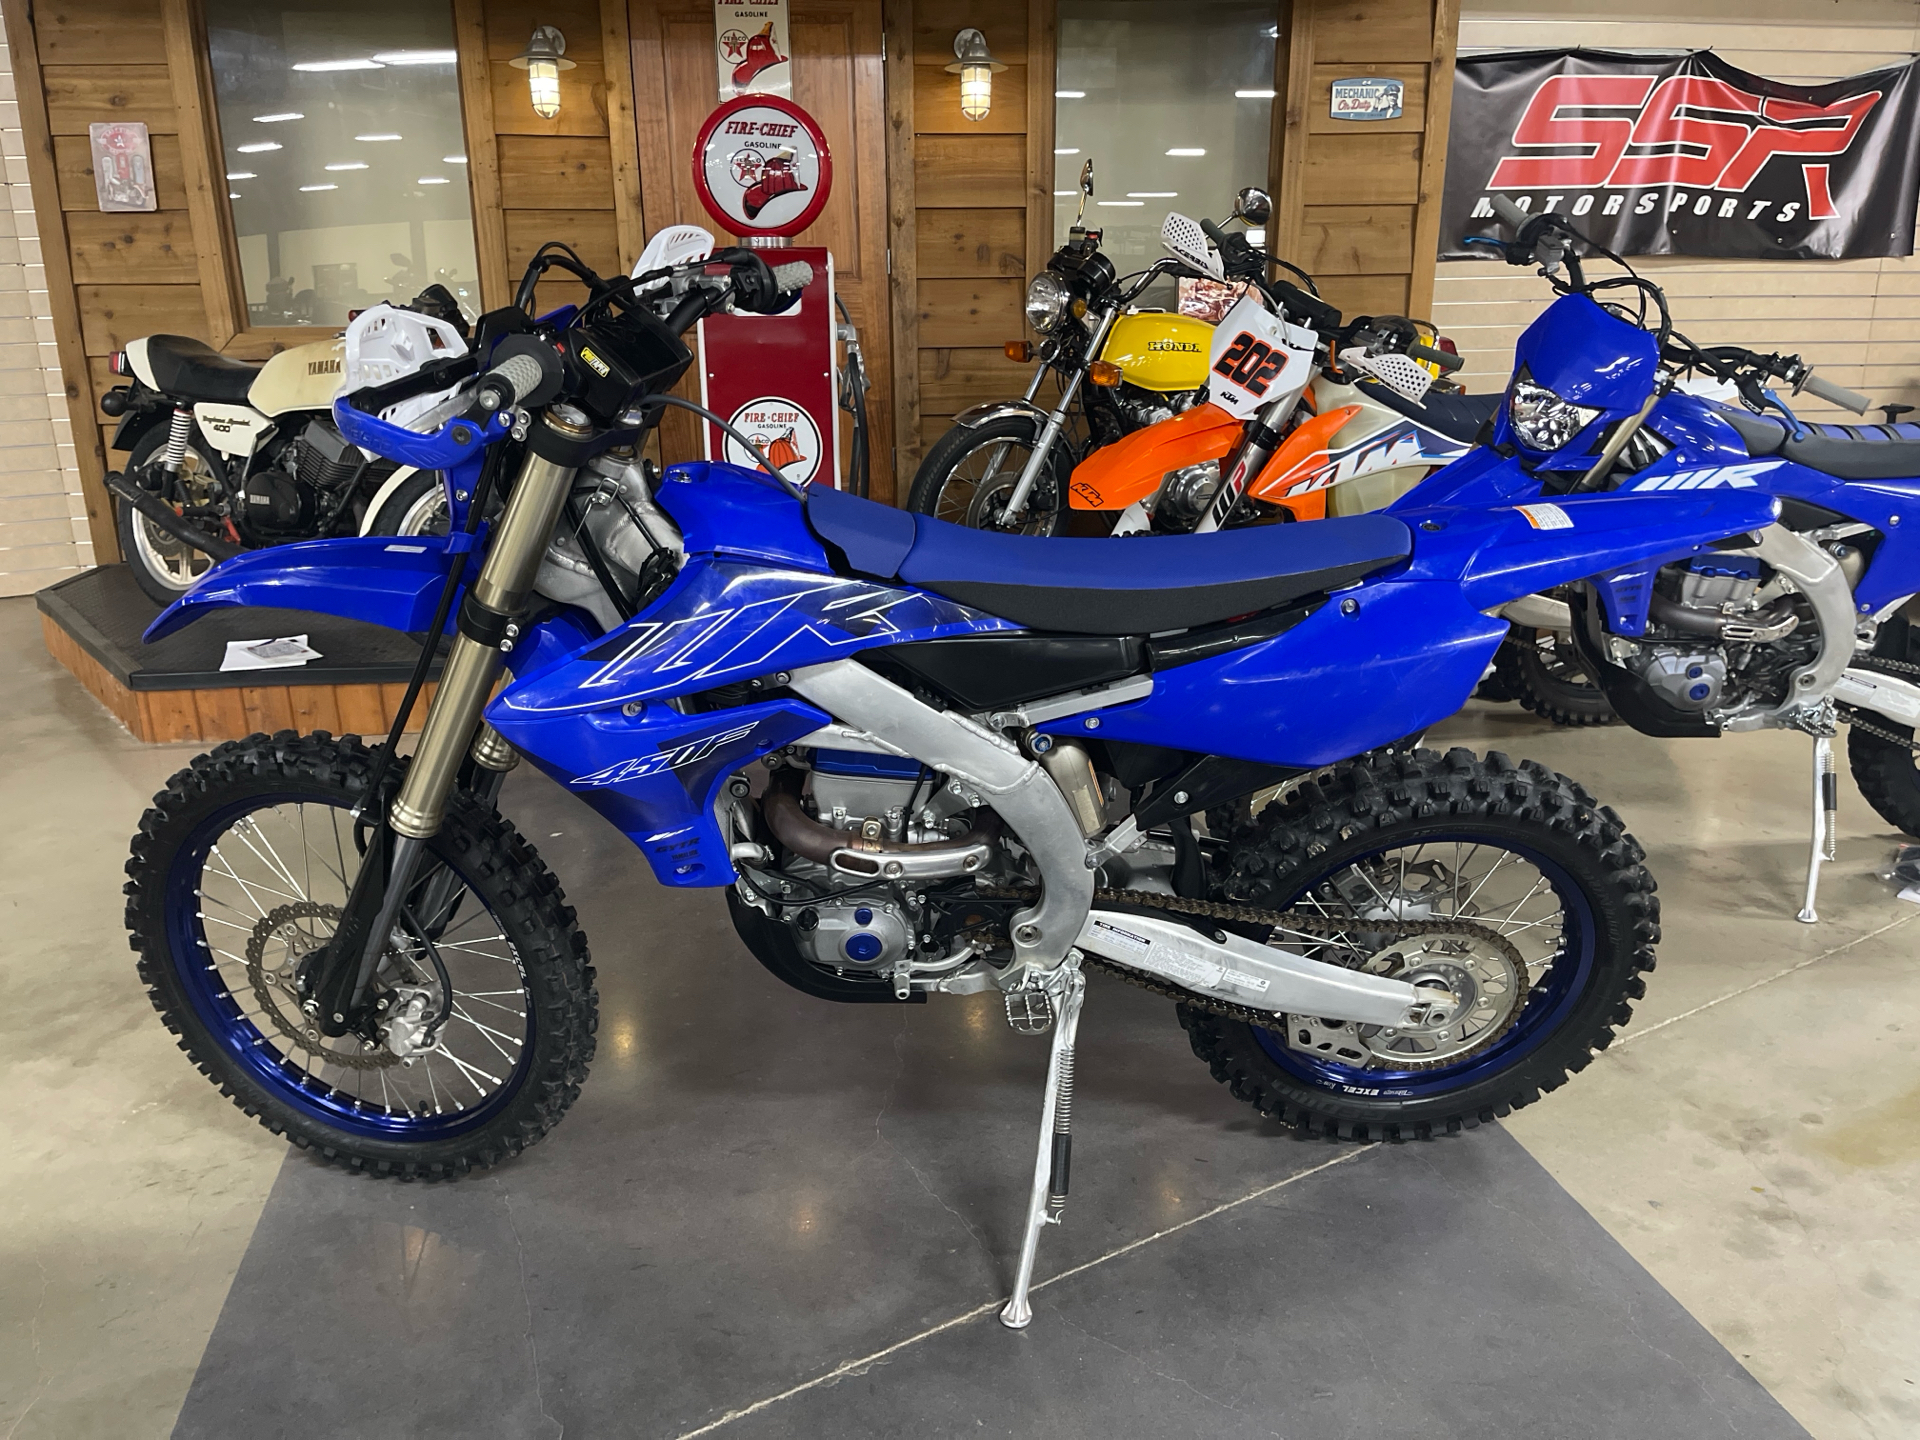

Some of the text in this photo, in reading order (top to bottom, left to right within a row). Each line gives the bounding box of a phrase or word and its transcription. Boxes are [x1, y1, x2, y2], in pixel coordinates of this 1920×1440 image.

[1335, 88, 1380, 99] MECHANIC
[1351, 98, 1372, 112] Duty
[725, 121, 799, 138] FIRE-CHIEF
[1485, 74, 1883, 221] SSR
[1470, 192, 1801, 223] MOTORSPORTS
[1148, 341, 1203, 353] HONDA
[308, 358, 342, 376] YAMAHA
[1212, 330, 1290, 399] 202
[1219, 391, 1240, 406] KTM
[213, 424, 232, 433] 400
[1070, 481, 1104, 508] KTM
[1211, 460, 1248, 528] WP
[569, 720, 761, 787] 450F
[655, 837, 701, 853] GYTR
[507, 941, 527, 980] EXCEL
[1342, 1084, 1380, 1096] EXCEL
